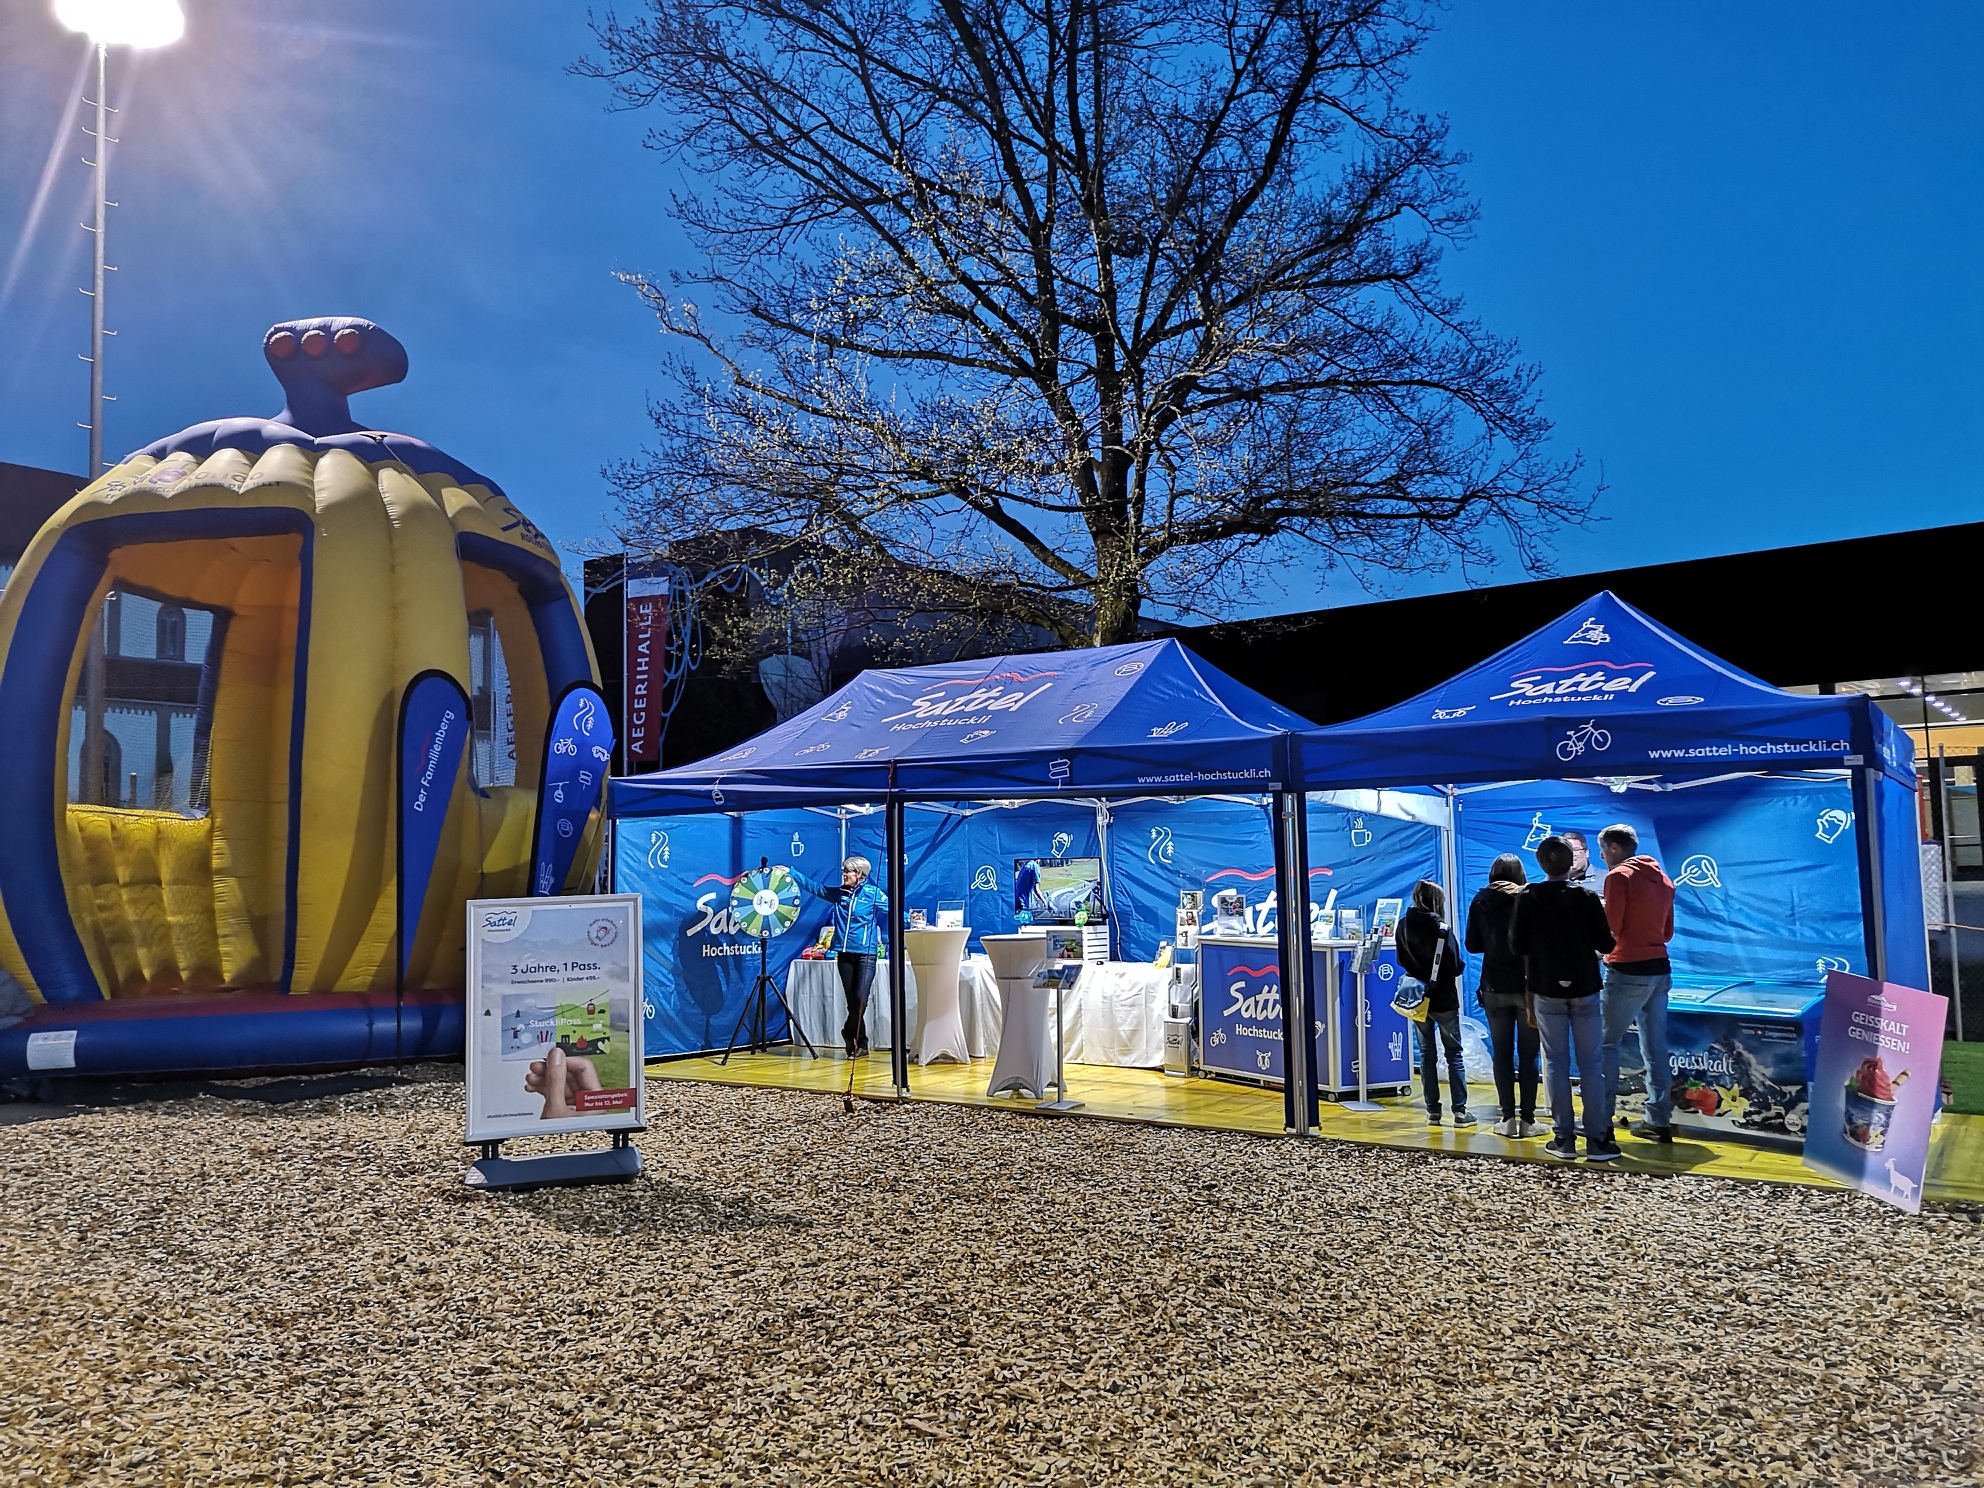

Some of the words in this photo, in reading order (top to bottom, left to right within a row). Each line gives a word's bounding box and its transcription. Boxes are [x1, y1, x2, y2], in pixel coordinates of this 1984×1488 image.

[631, 603, 652, 754] AEGERIHALLE
[1490, 671, 1656, 700] Sattel
[881, 682, 1053, 723] Sattel
[1508, 694, 1615, 706] Hochstuckli
[889, 714, 992, 732] Hochstuckli
[413, 789, 428, 812] Der
[421, 710, 455, 787] Familienberg
[1648, 739, 1850, 759] www.sattel-hochstuckli.ch
[1138, 768, 1271, 783] www.sattel-hochstuckli.ch
[482, 916, 518, 928] Sattel
[510, 965, 518, 974] 3
[521, 963, 560, 974] Jahre,
[563, 962, 568, 972] 1
[571, 961, 601, 971] Pass.
[1223, 981, 1283, 1020] Satt
[1235, 1023, 1284, 1041] Hochstuck
[1851, 1011, 1909, 1036] GEISSKALT
[1848, 1026, 1910, 1054] GENIESSEN!
[1669, 1051, 1735, 1076] geisskalt
